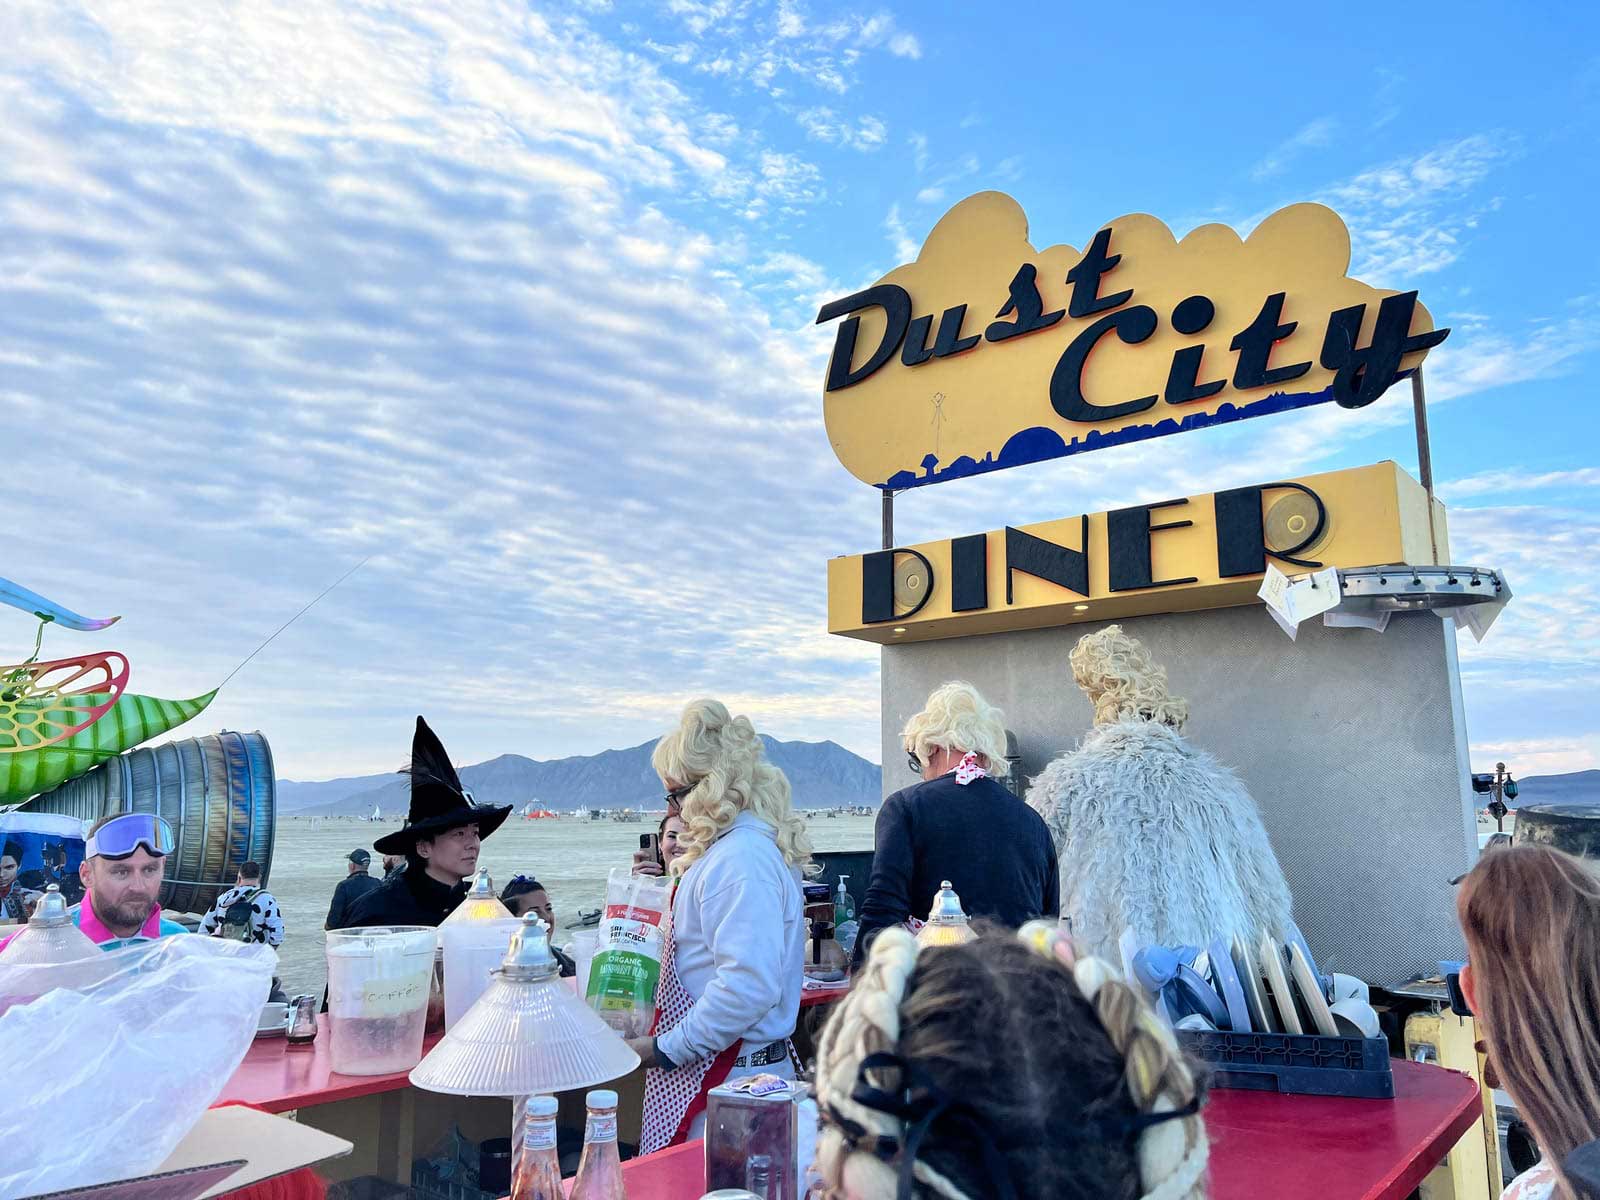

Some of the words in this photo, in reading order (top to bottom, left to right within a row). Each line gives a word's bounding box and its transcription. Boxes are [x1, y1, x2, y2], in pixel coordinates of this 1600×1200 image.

[815, 228, 1134, 392] Dust
[1049, 289, 1451, 422] City
[861, 481, 1326, 624] DINER
[608, 956, 642, 966] ORGANIC
